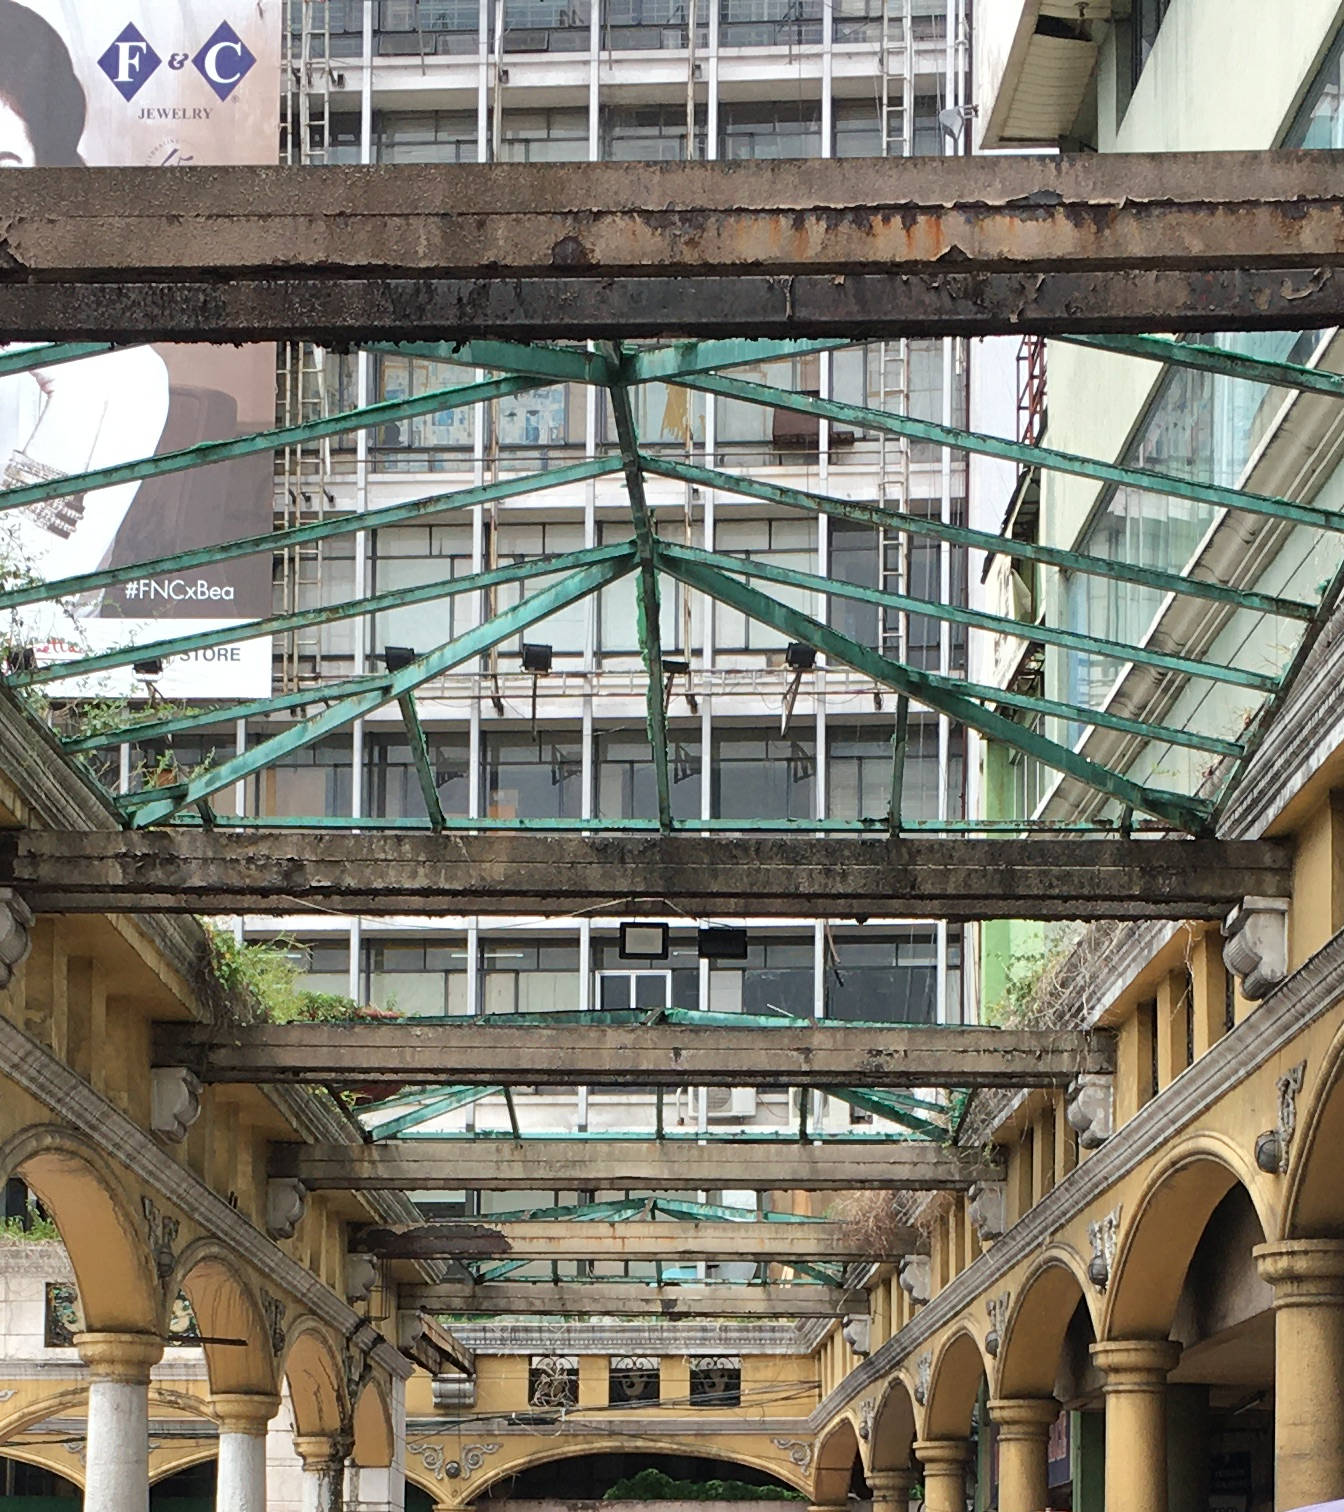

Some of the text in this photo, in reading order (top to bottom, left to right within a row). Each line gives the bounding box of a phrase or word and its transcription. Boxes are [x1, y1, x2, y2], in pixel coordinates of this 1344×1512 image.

[113, 42, 242, 84] F & C
[138, 107, 214, 120] JEWELRY
[125, 580, 234, 600] #FNCxBea
